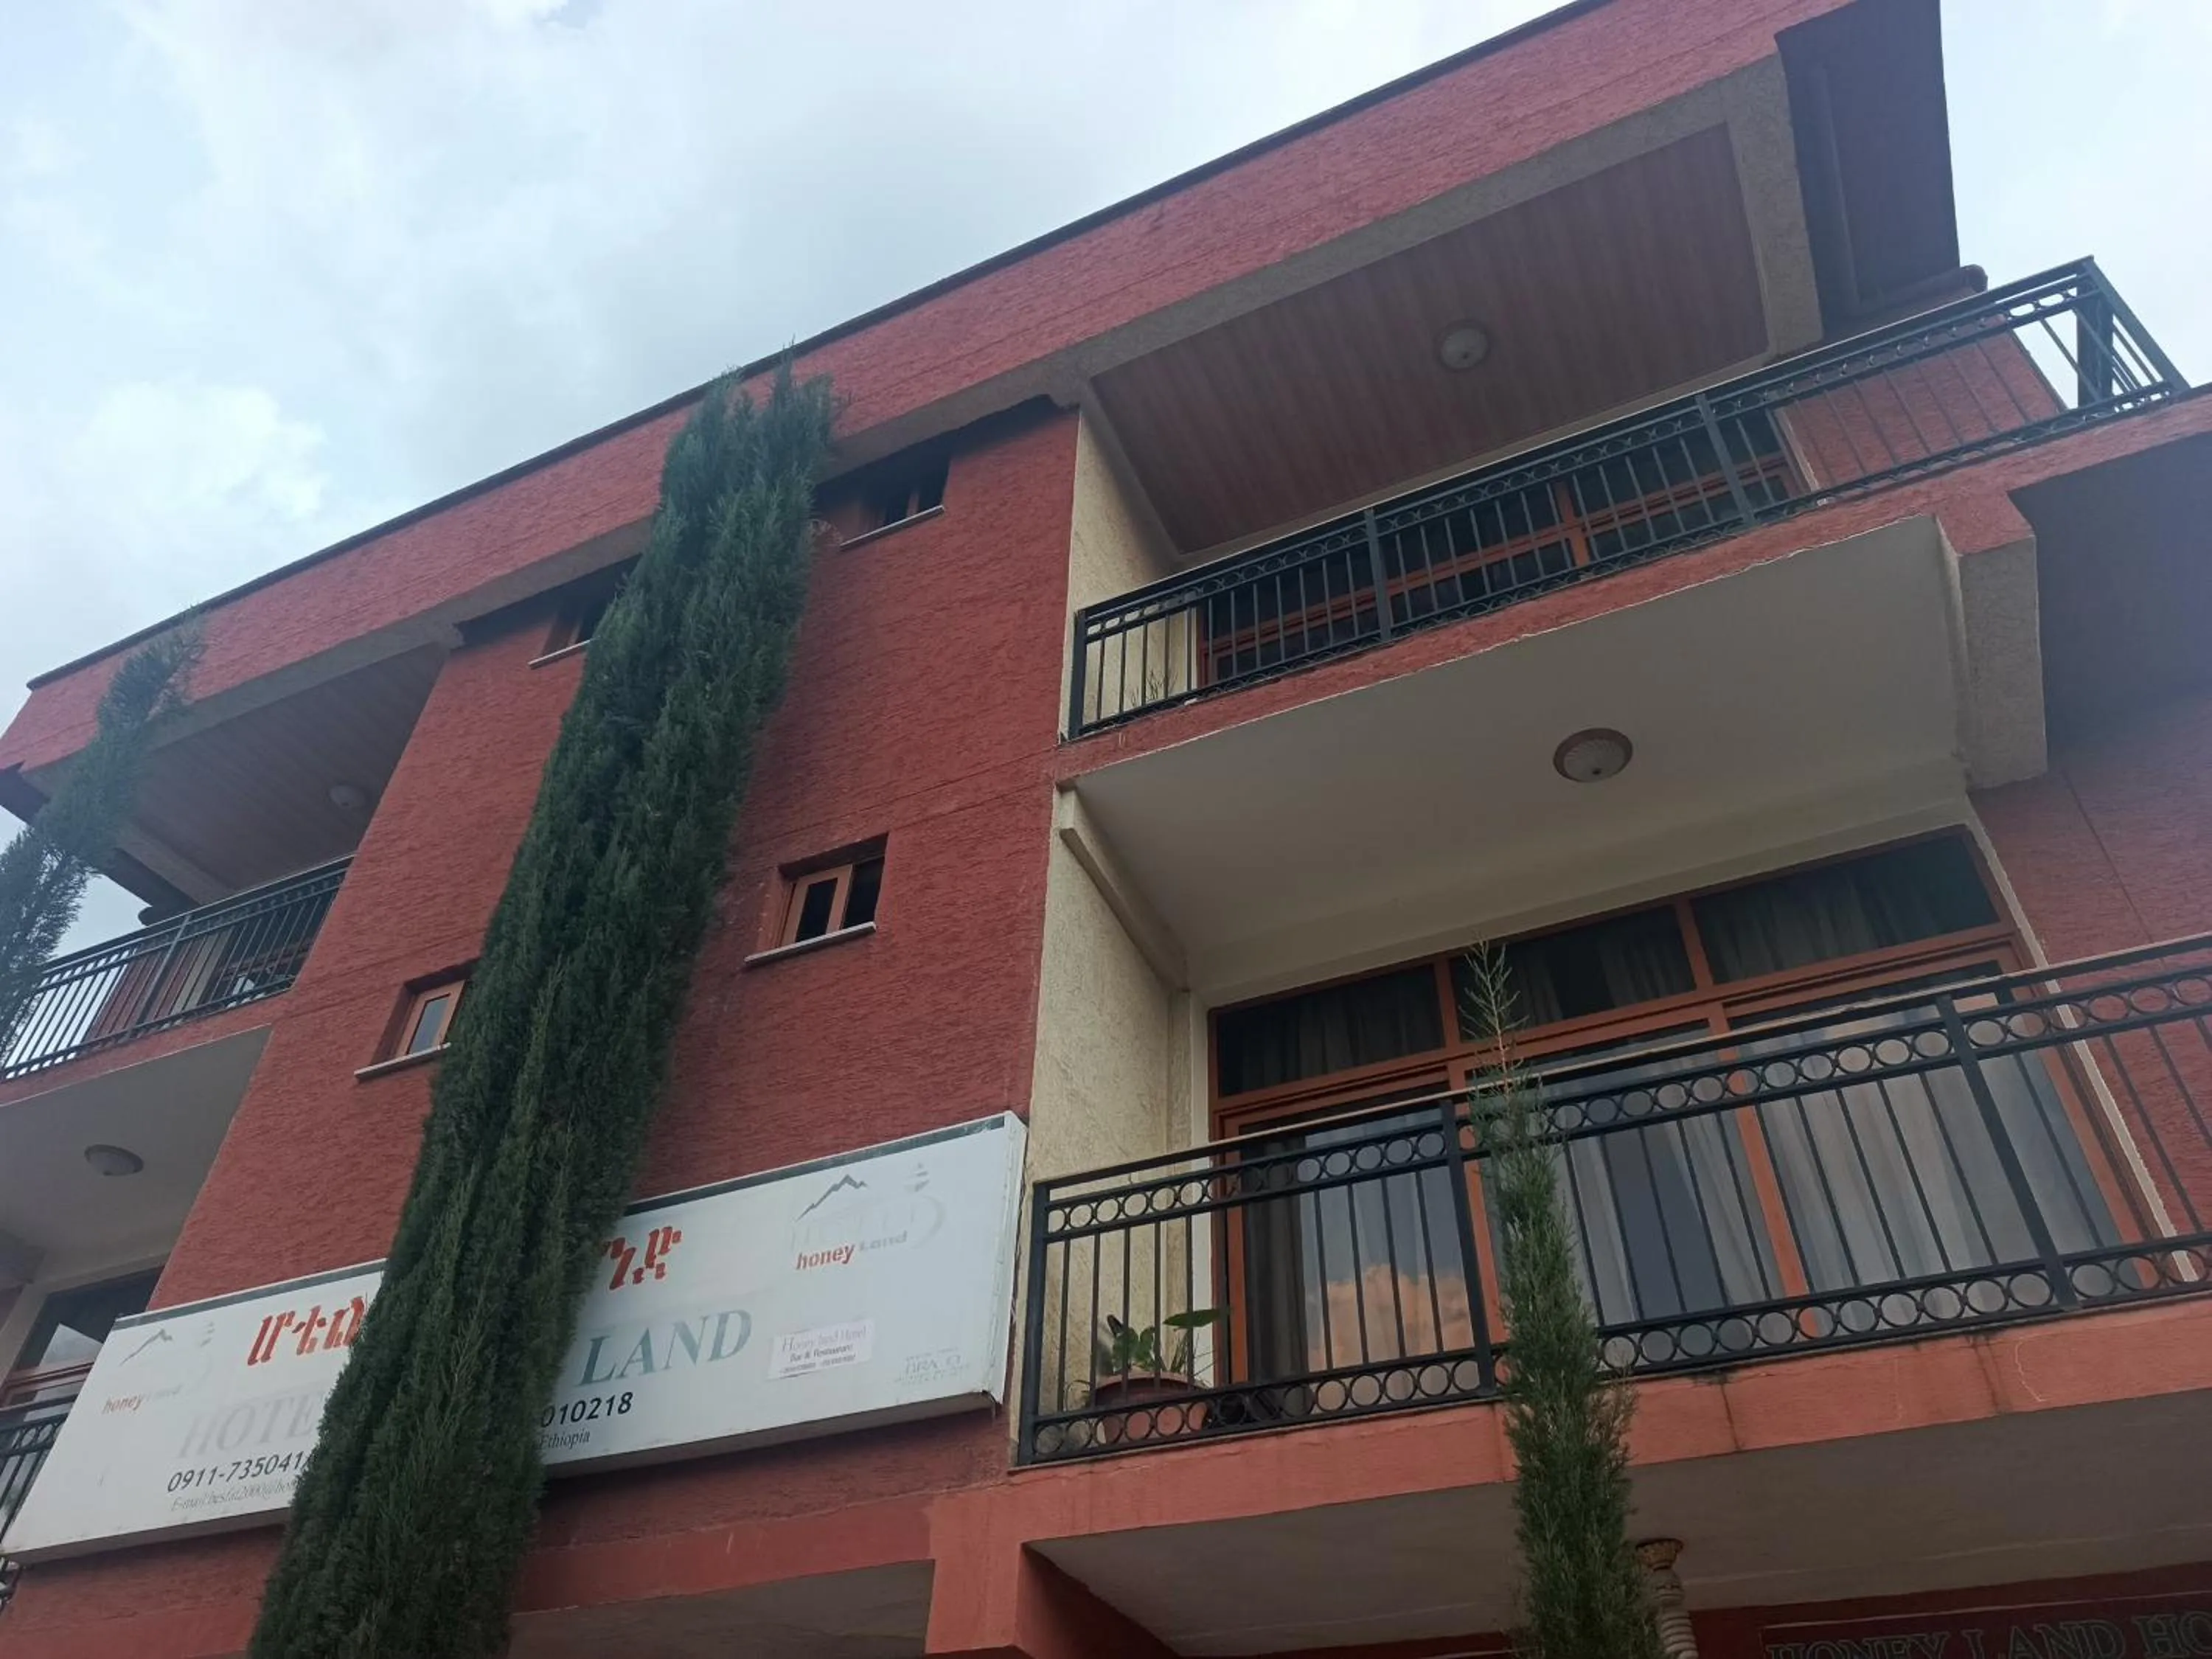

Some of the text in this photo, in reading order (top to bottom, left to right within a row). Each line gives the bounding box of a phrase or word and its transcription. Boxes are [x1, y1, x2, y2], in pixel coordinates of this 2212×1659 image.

[796, 1242, 855, 1270] honey
[178, 1309, 753, 1458] HOTE LAND
[100, 1392, 145, 1416] honey
[540, 1391, 634, 1428] 010218
[1961, 1620, 2126, 1659] LAND
[2132, 1610, 2212, 1659] HO
